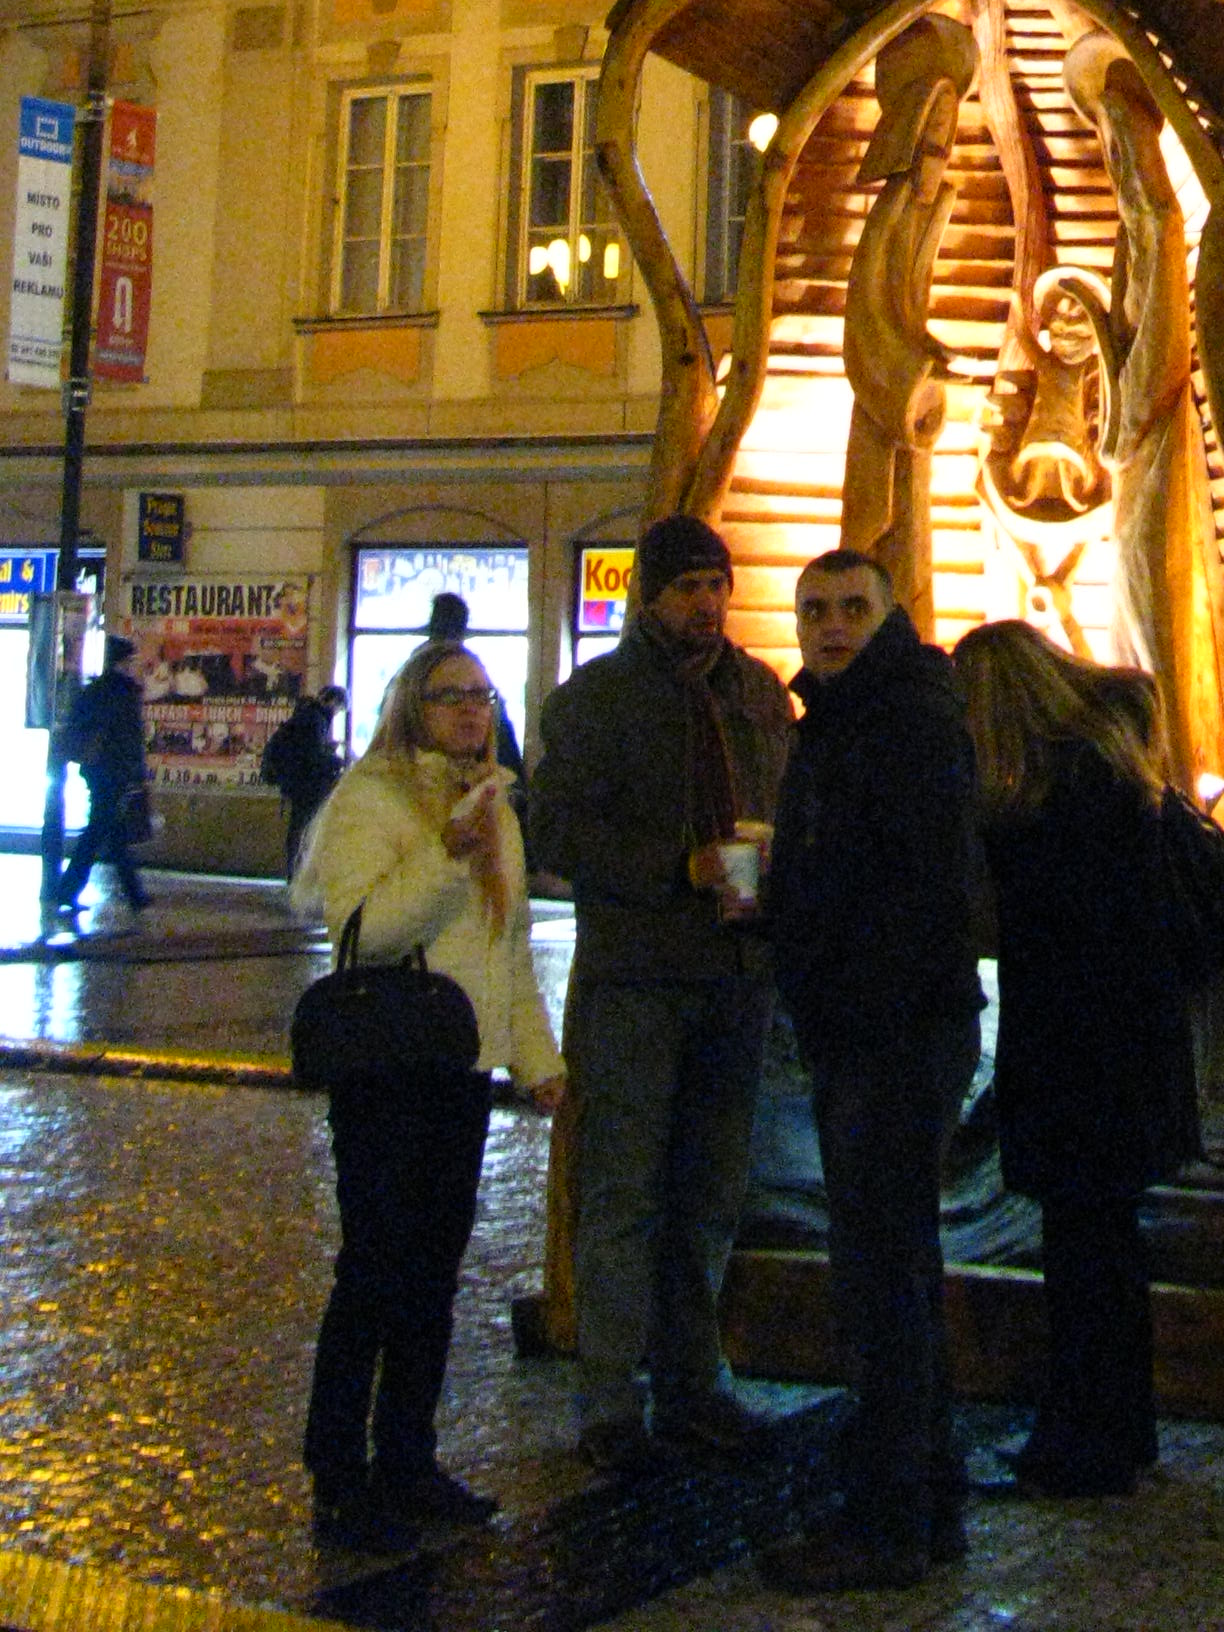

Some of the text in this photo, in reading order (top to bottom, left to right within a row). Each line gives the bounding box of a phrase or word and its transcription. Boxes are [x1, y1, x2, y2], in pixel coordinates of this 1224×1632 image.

[31, 223, 53, 238] PRO
[108, 216, 149, 246] 200
[131, 583, 276, 616] RESTAURANT
